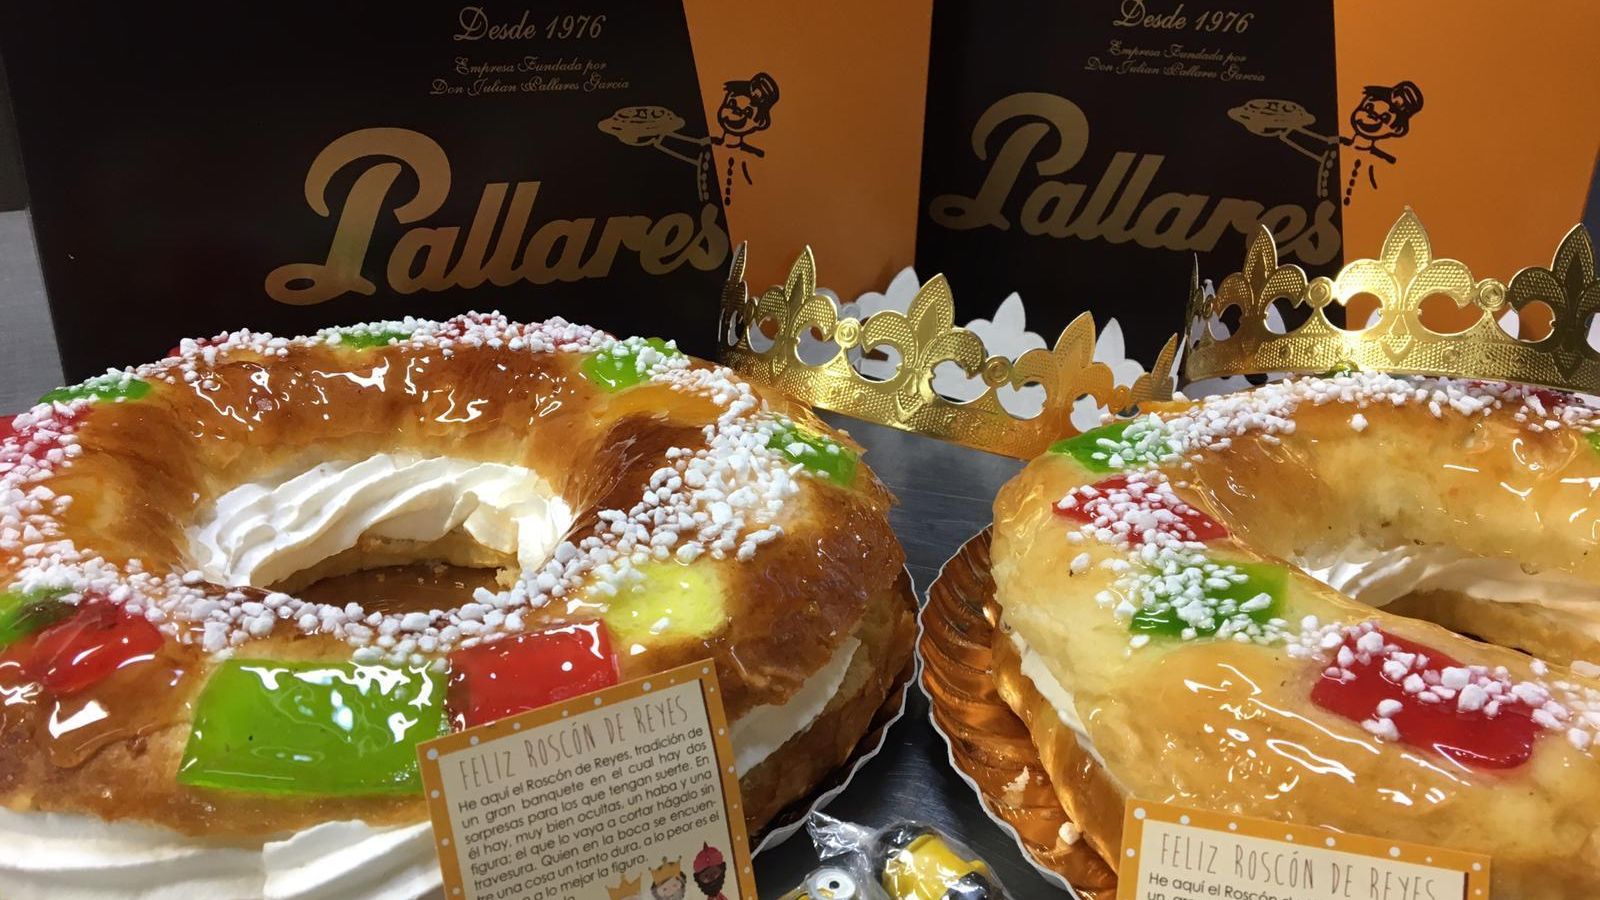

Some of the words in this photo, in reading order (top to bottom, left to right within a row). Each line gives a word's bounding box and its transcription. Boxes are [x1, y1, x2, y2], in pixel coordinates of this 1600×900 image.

[453, 6, 536, 41] Desde
[545, 14, 606, 39] 1976
[1113, 0, 1187, 30] Desde
[1195, 11, 1254, 34] 1976
[430, 78, 463, 95] Don
[521, 75, 579, 92] Pallares
[454, 56, 514, 78] Empresa
[517, 55, 582, 73] Fundada
[582, 61, 607, 76] por
[1085, 57, 1113, 71] Don
[265, 127, 729, 305] Pallares
[929, 92, 1341, 266] Pallares
[458, 800, 477, 813] He
[480, 786, 509, 806] aquí
[512, 782, 524, 796] el
[525, 769, 572, 791] Roscón
[574, 763, 591, 775] de
[634, 732, 685, 756] tradición
[687, 727, 703, 739] de
[459, 750, 515, 790] FELIZ
[523, 721, 596, 768] ROSCÓN
[603, 713, 625, 744] DE
[632, 695, 688, 733] REYES
[461, 816, 479, 829] un
[485, 804, 515, 823] gran
[521, 781, 584, 809] banquete
[590, 774, 606, 786] en
[611, 766, 623, 779] el
[628, 756, 654, 774] cual
[658, 750, 680, 764] hay
[686, 741, 707, 755] dos
[464, 817, 524, 845] sorpresas
[527, 806, 558, 826] para
[560, 799, 578, 812] los
[581, 790, 605, 806] que
[608, 775, 652, 795] tengan
[655, 762, 692, 781] suerte.
[695, 755, 709, 767] En
[468, 846, 480, 860] él
[515, 827, 542, 843] muy
[545, 816, 574, 833] bien
[627, 793, 643, 806] un
[645, 782, 677, 799] haba
[679, 779, 687, 789] y
[689, 770, 712, 784] una
[515, 846, 527, 860] el
[530, 839, 554, 855] que
[557, 834, 570, 845] lo
[573, 822, 604, 839] vaya
[607, 818, 616, 828] a
[619, 805, 653, 824] cortar
[656, 790, 698, 811] hágalo
[700, 783, 715, 796] sin
[474, 863, 537, 890] travesura.
[540, 847, 579, 867] Quien
[582, 840, 599, 852] en
[602, 834, 614, 845] la
[617, 822, 650, 840] boca
[653, 816, 666, 827] se
[669, 799, 716, 821] encuen-
[496, 883, 523, 899] una
[524, 871, 555, 889] cosa
[557, 864, 574, 877] un
[575, 852, 608, 869] tanto
[643, 836, 652, 846] a
[653, 832, 665, 842] lo
[666, 821, 693, 840] peor
[695, 816, 707, 827] es
[709, 810, 719, 822] el
[544, 886, 557, 897] lo
[560, 872, 594, 891] mejor
[597, 867, 609, 878] la
[611, 854, 648, 874] figura.
[1149, 872, 1168, 887] He
[1172, 879, 1205, 893] aquí
[1207, 884, 1220, 896] el
[1161, 832, 1218, 874] FELIZ
[1234, 844, 1313, 889] ROSCÓN
[1331, 862, 1353, 897] DE
[1370, 866, 1435, 900] REYES
